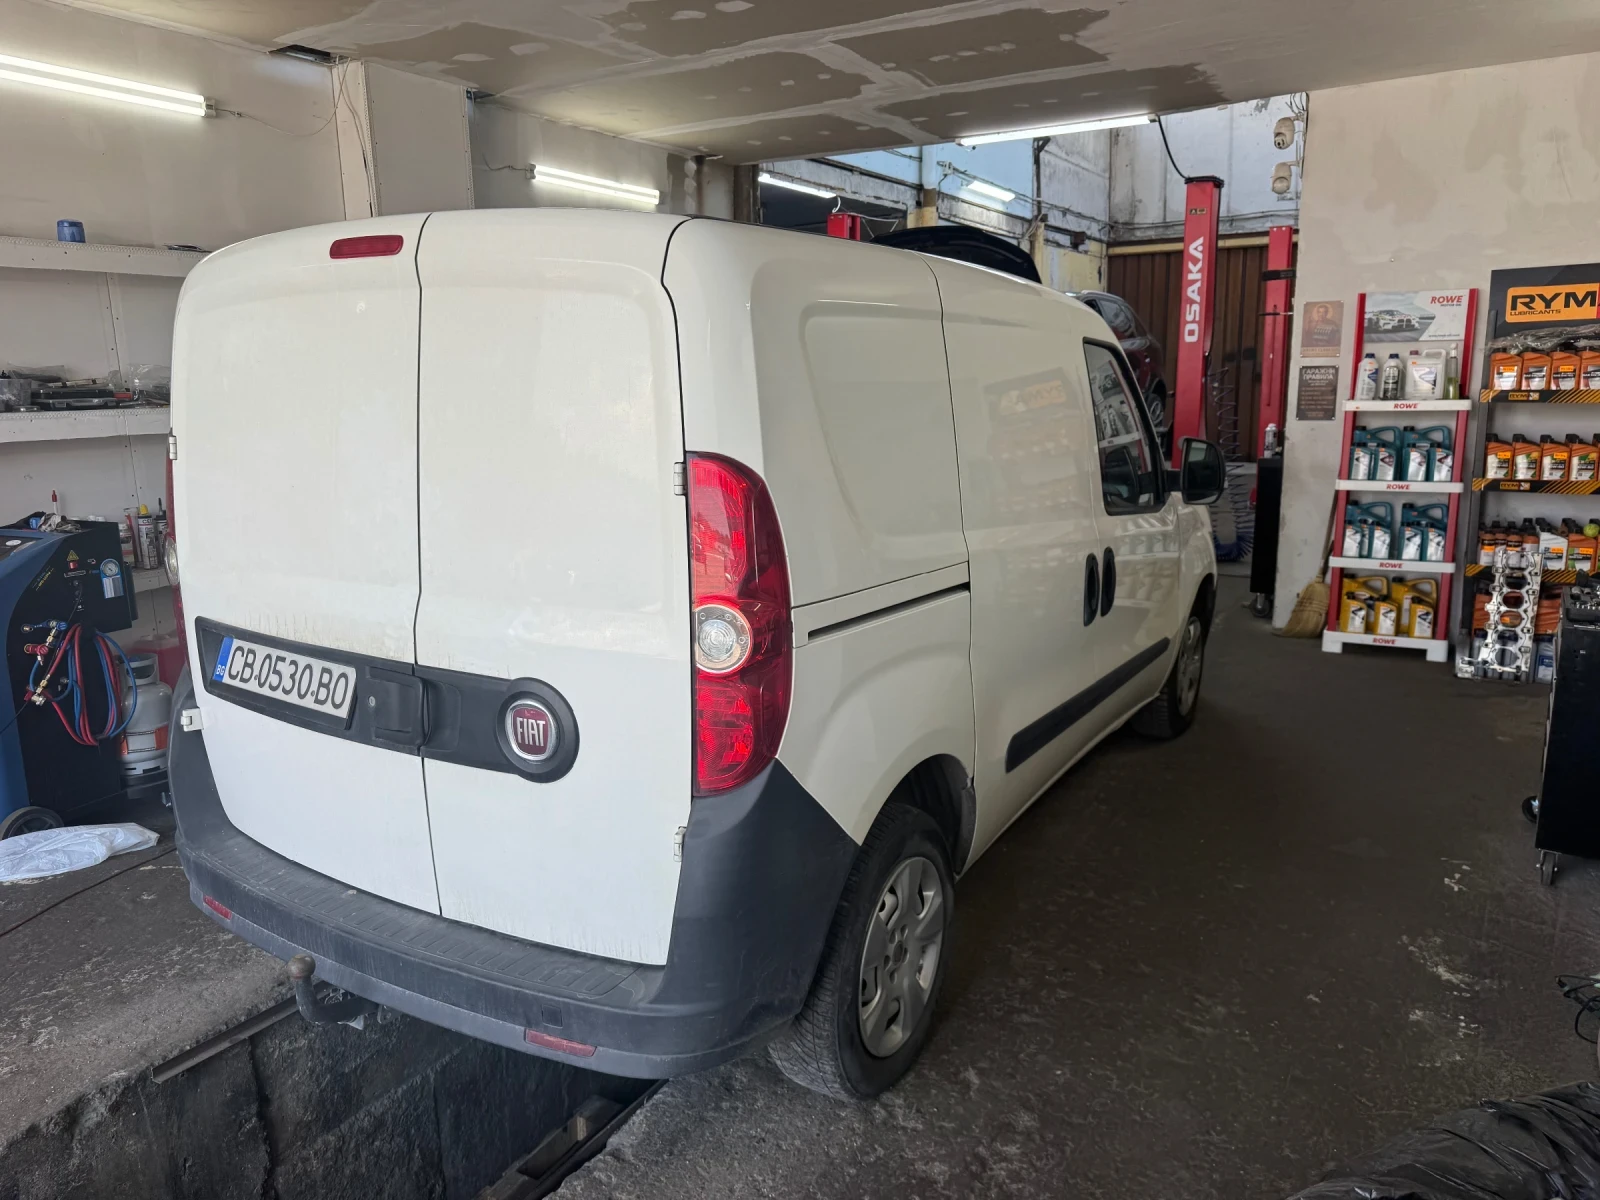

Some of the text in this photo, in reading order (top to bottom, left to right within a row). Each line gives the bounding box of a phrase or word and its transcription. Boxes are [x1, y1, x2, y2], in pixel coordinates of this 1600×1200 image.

[1184, 236, 1204, 343] OSAKA
[1430, 295, 1464, 304] ROWE
[1510, 291, 1600, 311] RYM
[1372, 637, 1396, 645] ROWE
[216, 664, 226, 676] BG
[516, 716, 546, 747] FIAT
